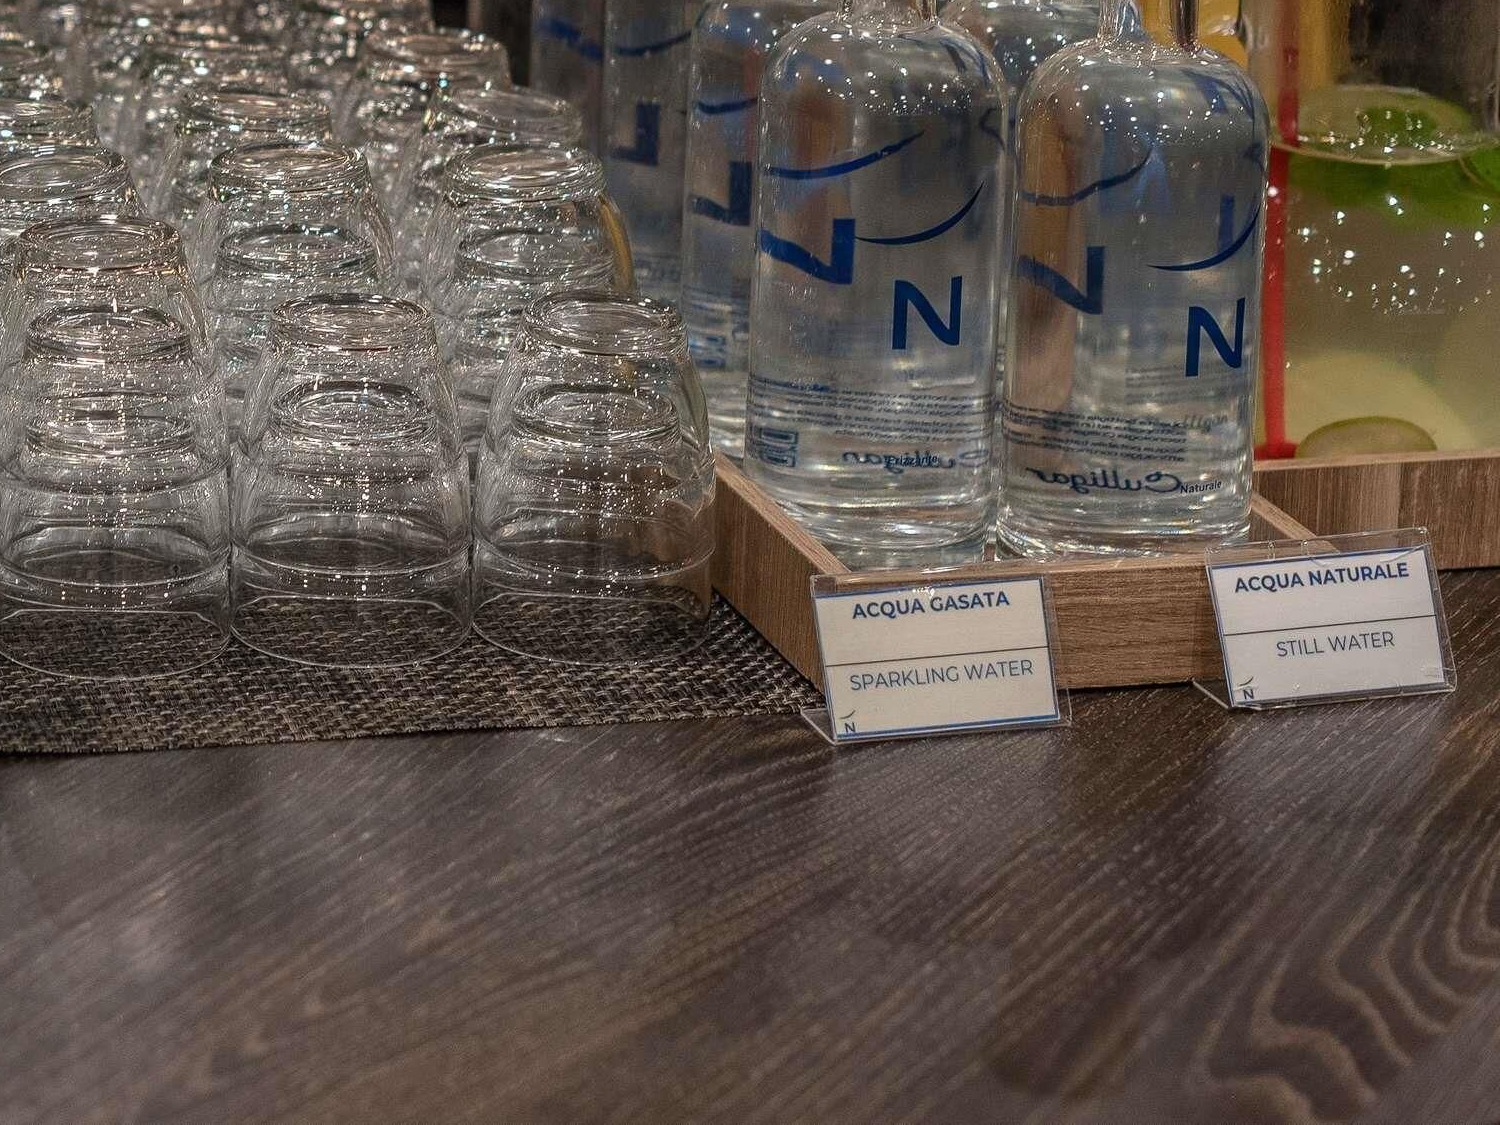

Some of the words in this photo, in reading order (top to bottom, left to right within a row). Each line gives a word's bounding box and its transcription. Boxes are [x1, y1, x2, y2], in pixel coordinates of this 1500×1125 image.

[891, 275, 963, 350] N
[1185, 297, 1246, 377] N
[1180, 479, 1223, 494] Naturale
[1234, 572, 1305, 593] ACQUA
[1308, 562, 1410, 585] NATURALE
[852, 597, 926, 620] ACQUA
[930, 590, 1011, 612] GASATA
[1276, 637, 1325, 657] STILL
[1327, 631, 1396, 651] WATER
[849, 665, 960, 691] SPARKLING
[963, 659, 1034, 681] WATER
